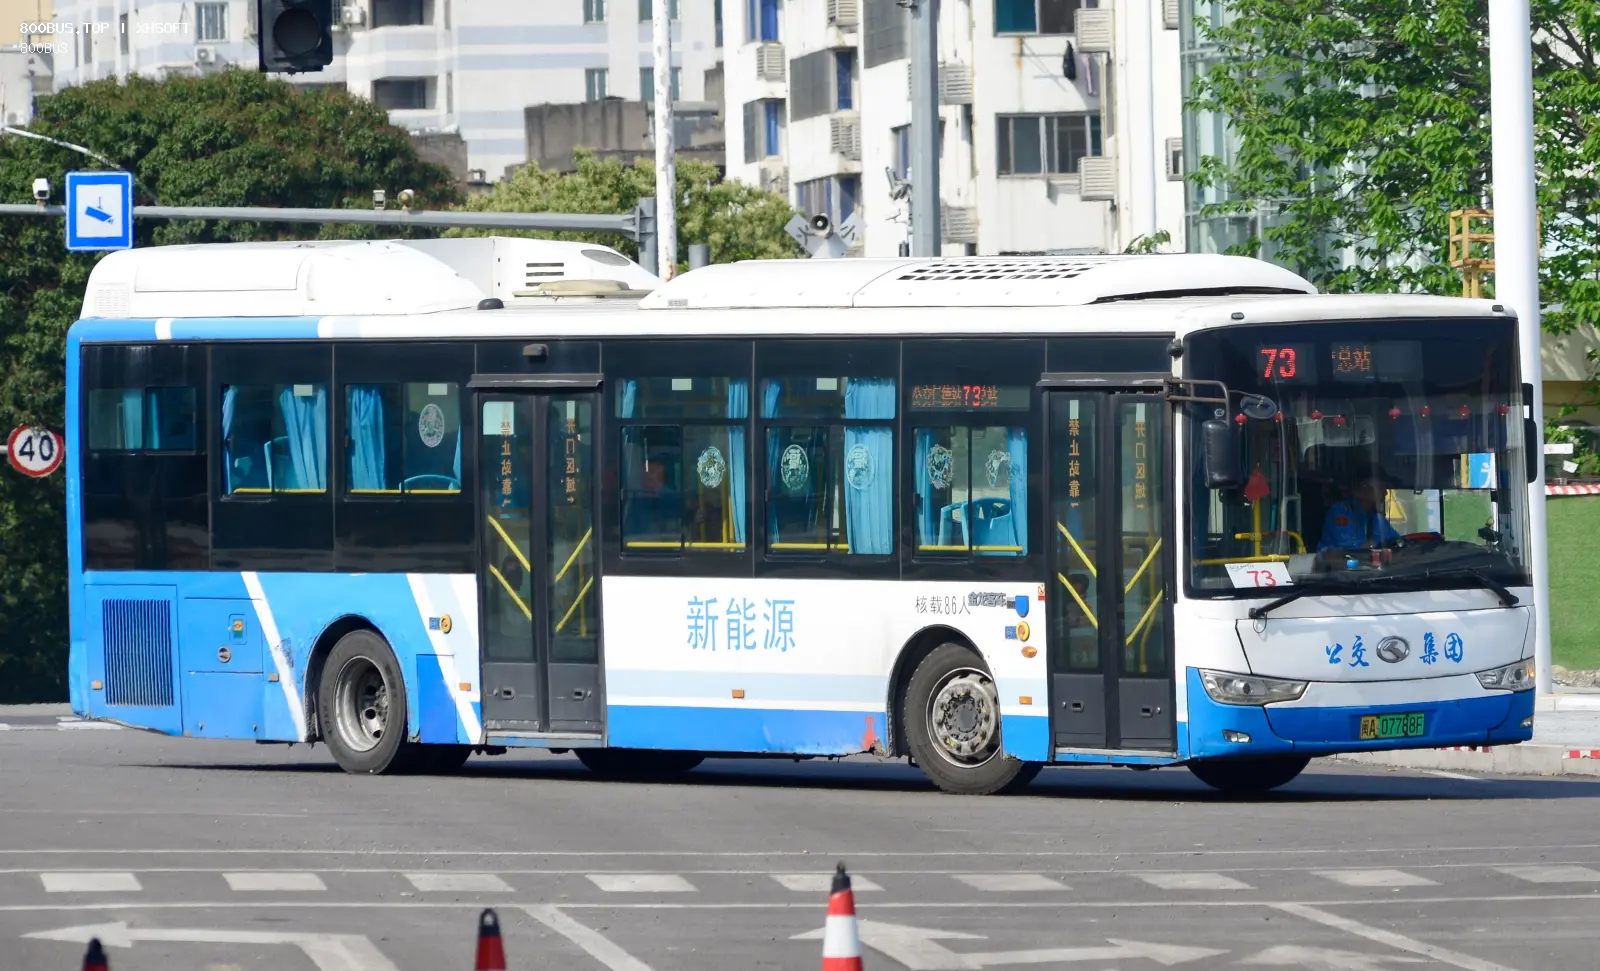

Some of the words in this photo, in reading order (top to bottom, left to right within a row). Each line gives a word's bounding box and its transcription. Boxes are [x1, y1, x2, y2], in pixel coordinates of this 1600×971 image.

[1261, 348, 1296, 378] 73
[1331, 345, 1371, 373] 总站
[19, 435, 54, 461] 40
[1247, 569, 1277, 587] 73
[915, 595, 971, 615] 核载86人
[686, 595, 796, 653] 新能源
[1325, 635, 1370, 668] 公交
[1419, 631, 1464, 665] 集团
